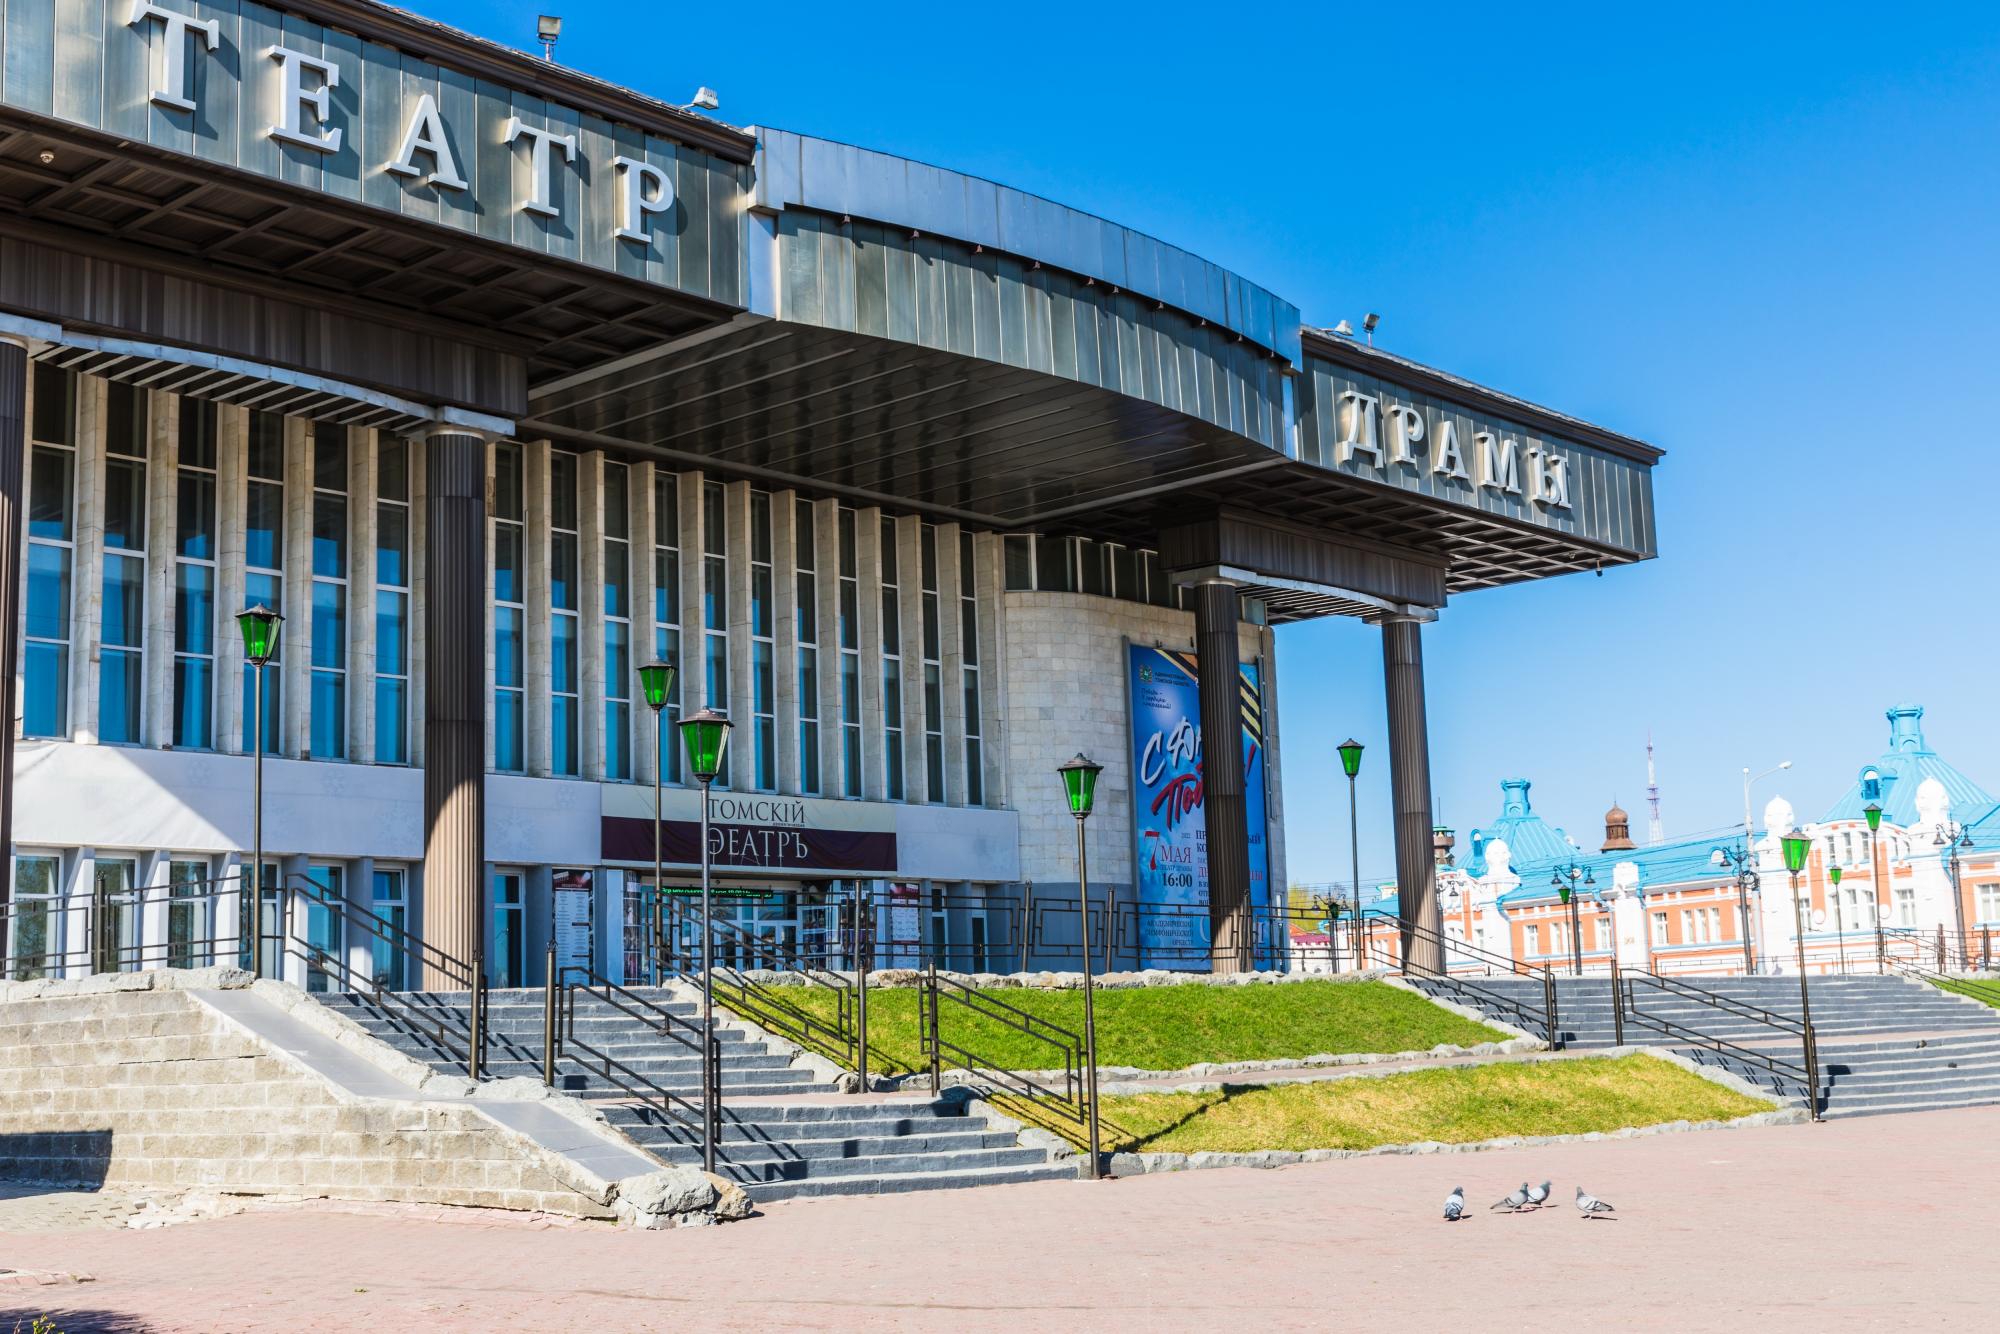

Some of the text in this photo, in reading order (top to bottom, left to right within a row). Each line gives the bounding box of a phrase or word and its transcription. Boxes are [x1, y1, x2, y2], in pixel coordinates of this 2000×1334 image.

[127, 0, 675, 245] ТЕАТР
[1341, 390, 1572, 509] ДРАМЫ
[1144, 830, 1192, 871] 7 МАЯ
[1162, 872, 1193, 888] 16:00
